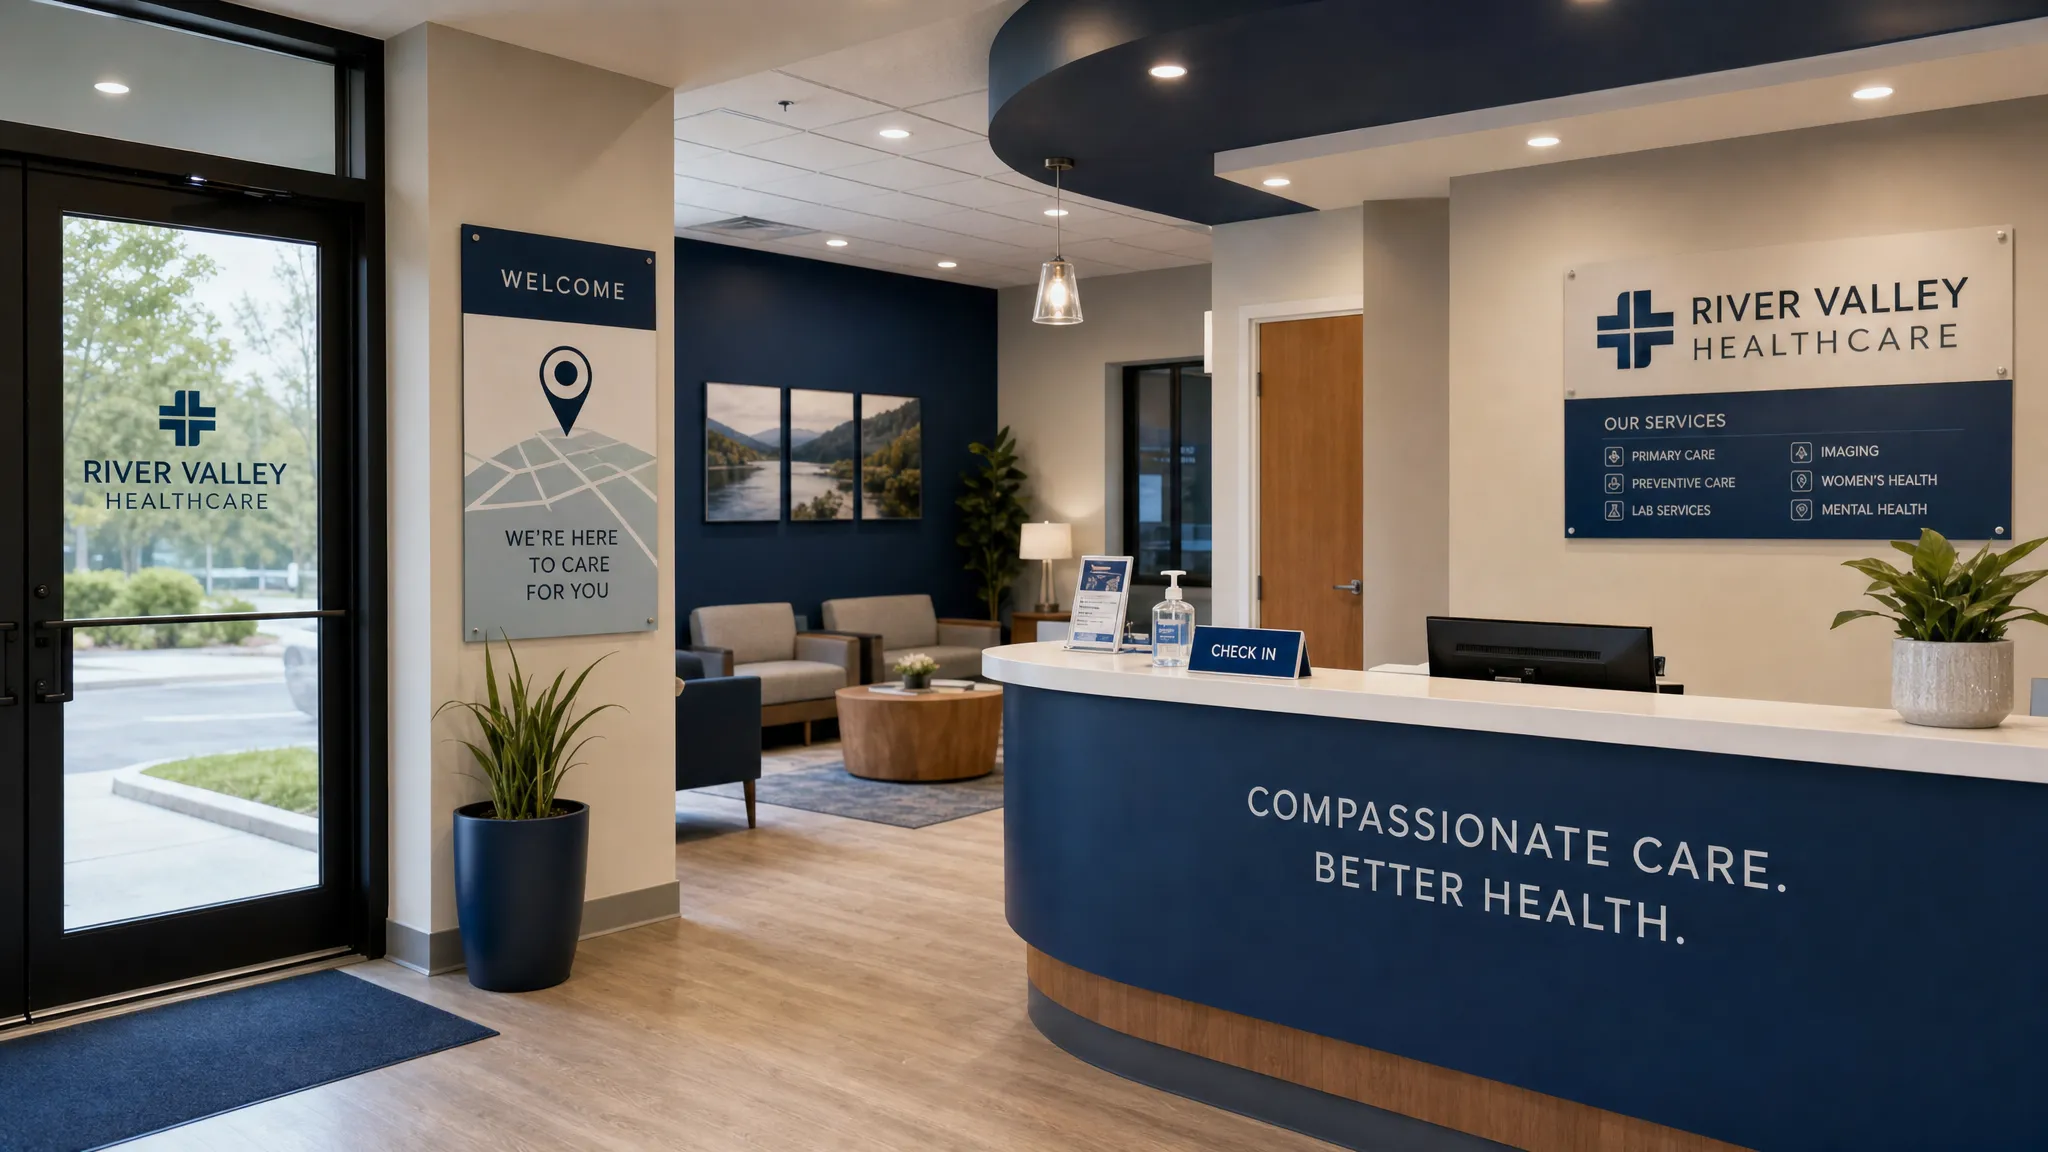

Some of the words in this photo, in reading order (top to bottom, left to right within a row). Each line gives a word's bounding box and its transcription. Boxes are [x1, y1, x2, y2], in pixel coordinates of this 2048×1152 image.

[501, 268, 625, 301] WELCOME
[1692, 289, 1800, 325] RIVER
[1814, 276, 1969, 317] VALLEY
[1693, 322, 1959, 361] HEALTHCARE
[1604, 416, 1640, 431] OUR
[1645, 413, 1727, 430] SERVICES
[1631, 450, 1682, 462] PRIMARY
[1684, 449, 1716, 461] CARE
[1820, 445, 1880, 458] IMAGING
[84, 459, 172, 484] RIVER
[181, 461, 287, 485] VALLEY
[1821, 474, 1885, 487] WOMEN'S
[1888, 473, 1938, 486] HEALTH
[1631, 477, 1702, 490] PREVENTIVE
[1704, 476, 1736, 489] CARE
[106, 492, 268, 510] HEALTHCARE
[1821, 503, 1874, 516] MENTAL
[1877, 503, 1928, 516] HEALTH
[1631, 504, 1654, 517] LAB
[1656, 504, 1711, 516] SERVICES
[504, 529, 565, 547] WE'RE
[572, 529, 618, 546] HERE
[528, 556, 556, 574] TO
[561, 555, 610, 573] CARE
[526, 583, 565, 601] FOR
[570, 582, 609, 600] YOU
[1211, 643, 1257, 660] CHECK
[1261, 646, 1277, 661] IN
[1247, 785, 1610, 867] COMPASSIONATE
[1632, 836, 1787, 893] CARE.
[1315, 850, 1464, 907] BETTER
[1484, 877, 1685, 945] HEALTH.
